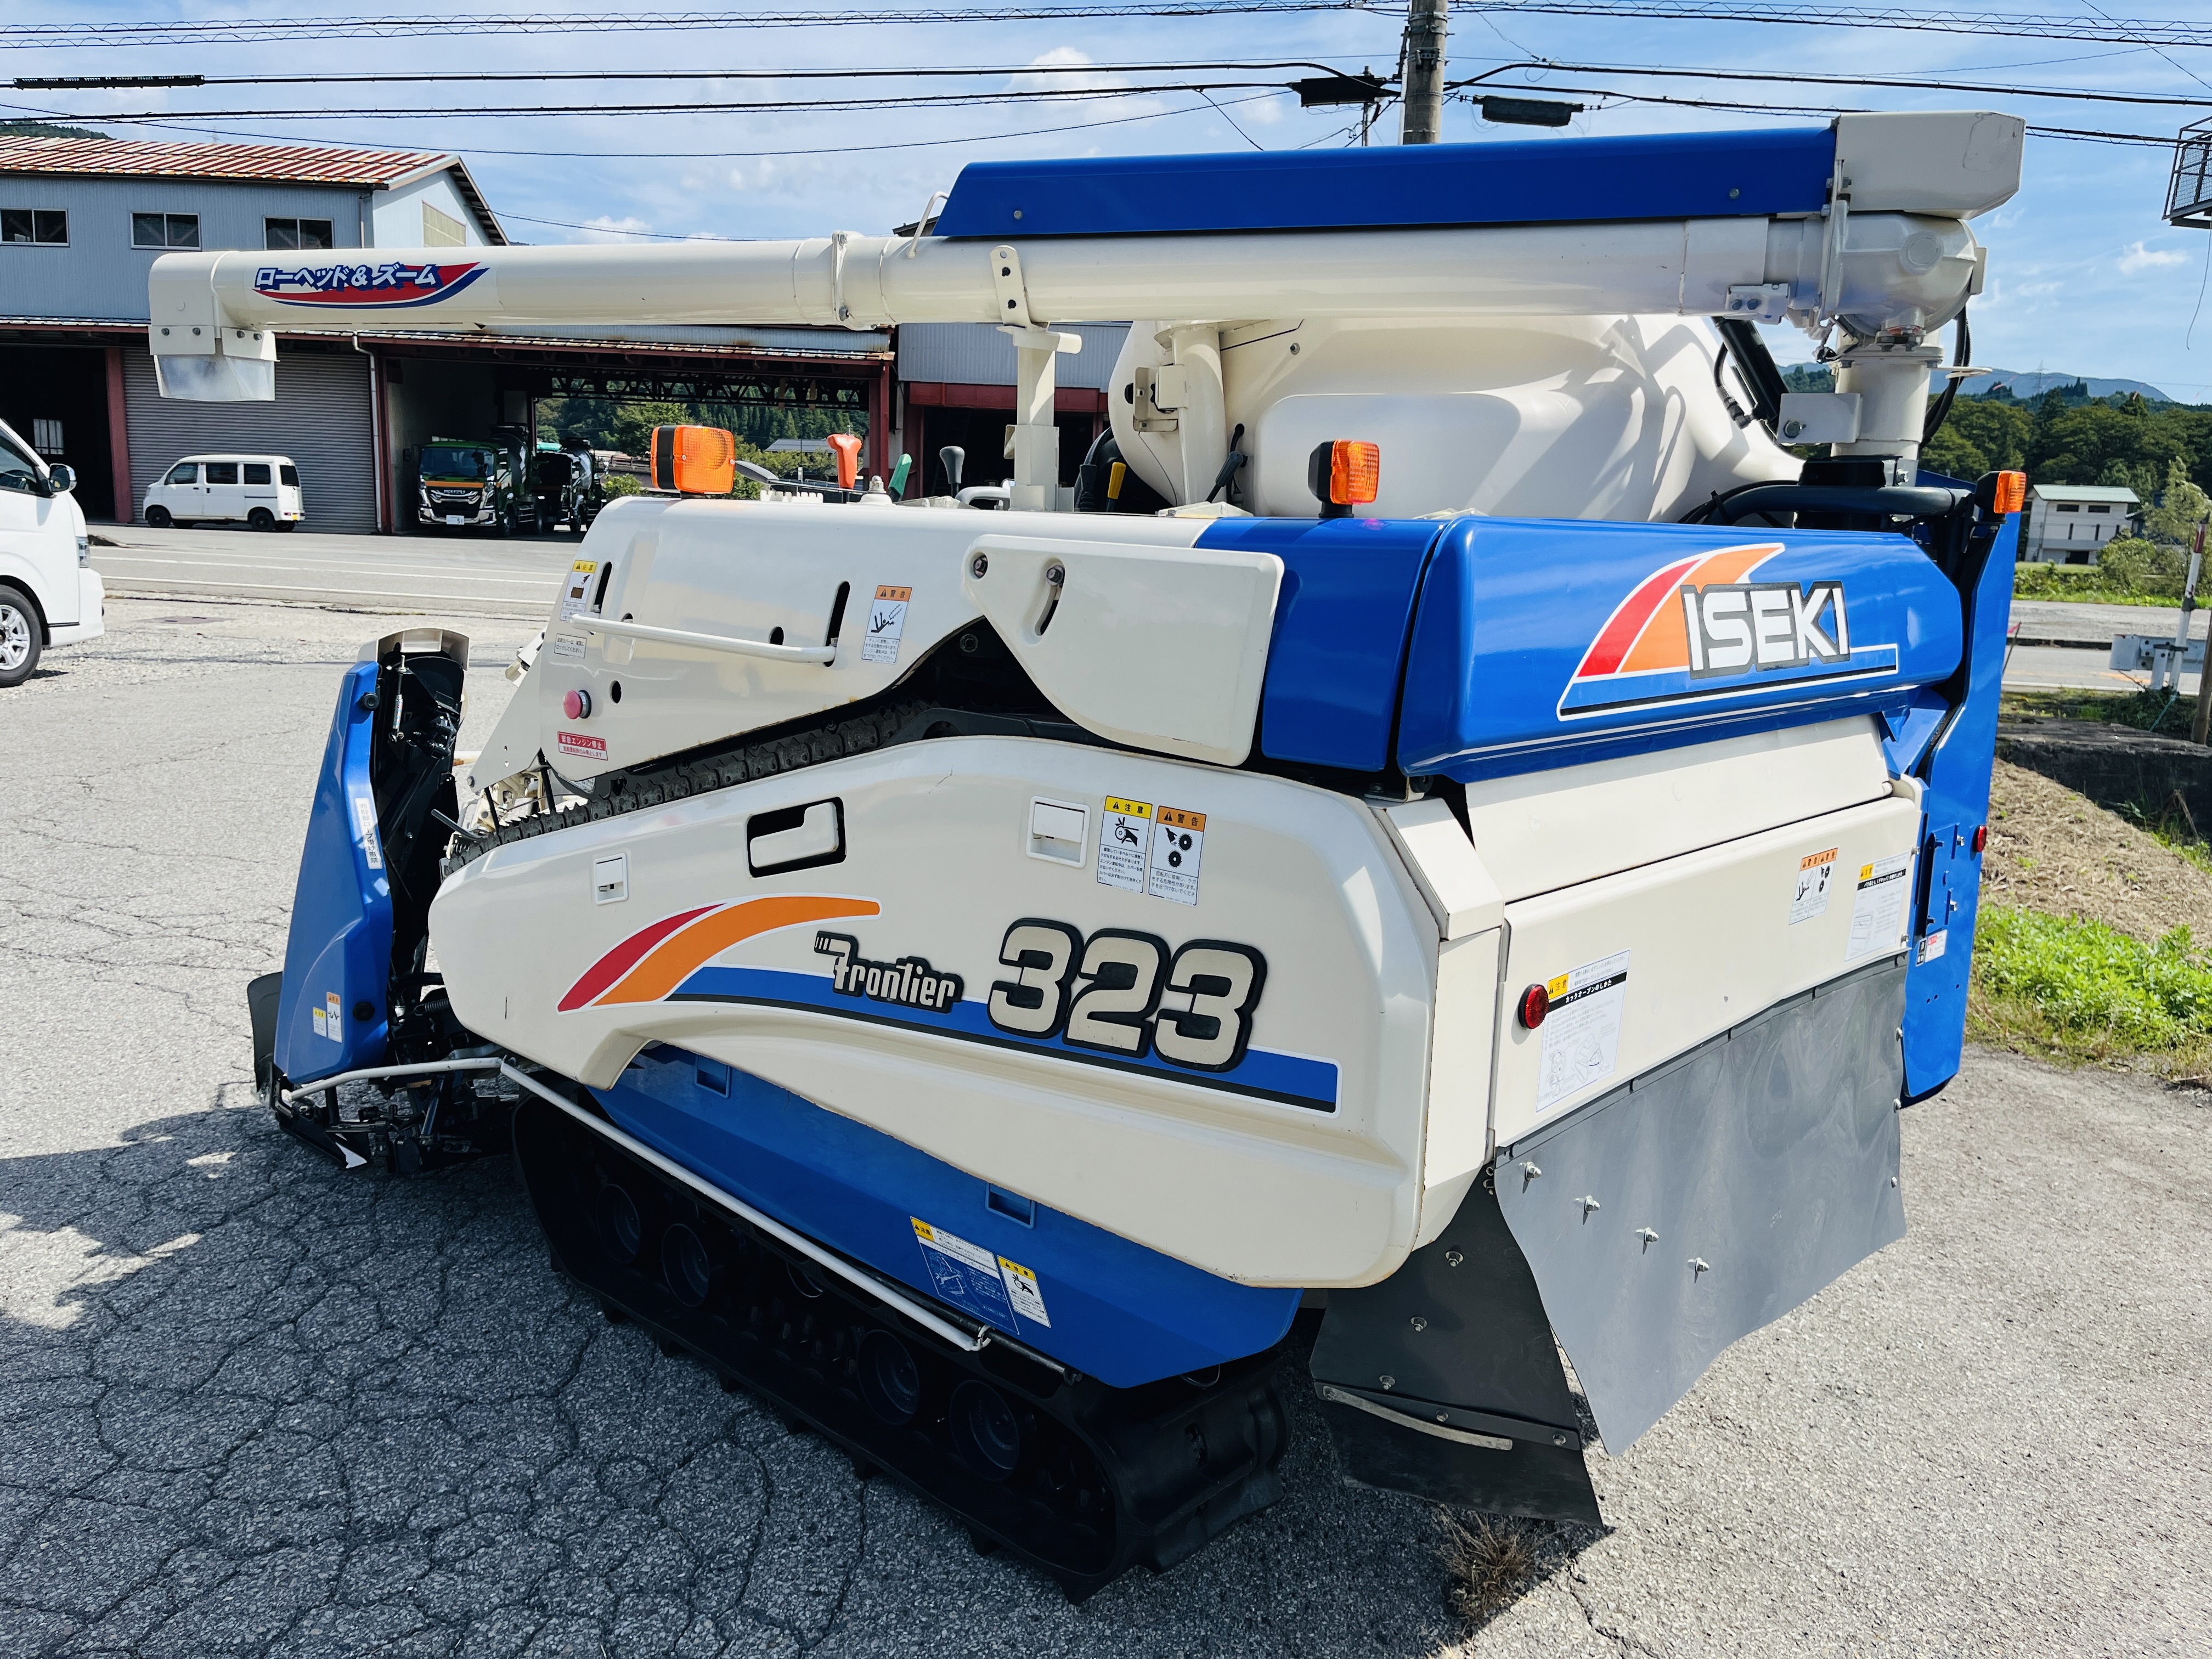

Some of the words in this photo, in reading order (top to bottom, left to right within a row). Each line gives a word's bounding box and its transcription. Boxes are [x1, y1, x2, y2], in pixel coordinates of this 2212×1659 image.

[255, 262, 438, 290] ローヘッド&ズーム
[1681, 583, 1851, 678] ISEKI
[561, 735, 602, 749] 緊急エンジン停止
[1125, 803, 1143, 814] 注意
[1177, 814, 1199, 826] 警告
[359, 803, 379, 864] 刈取部ロープ掛け厳禁
[1152, 876, 1195, 891] をする危険性があります。
[1152, 882, 1195, 897] 手を近づけないでくださ
[814, 933, 961, 1011] Frontier
[1556, 979, 1567, 991] 注意
[1565, 980, 1612, 1003] カッタオープンのしかた
[988, 920, 1263, 1070] 323
[921, 1228, 932, 1236] 注意
[1014, 1266, 1029, 1277] 注意
